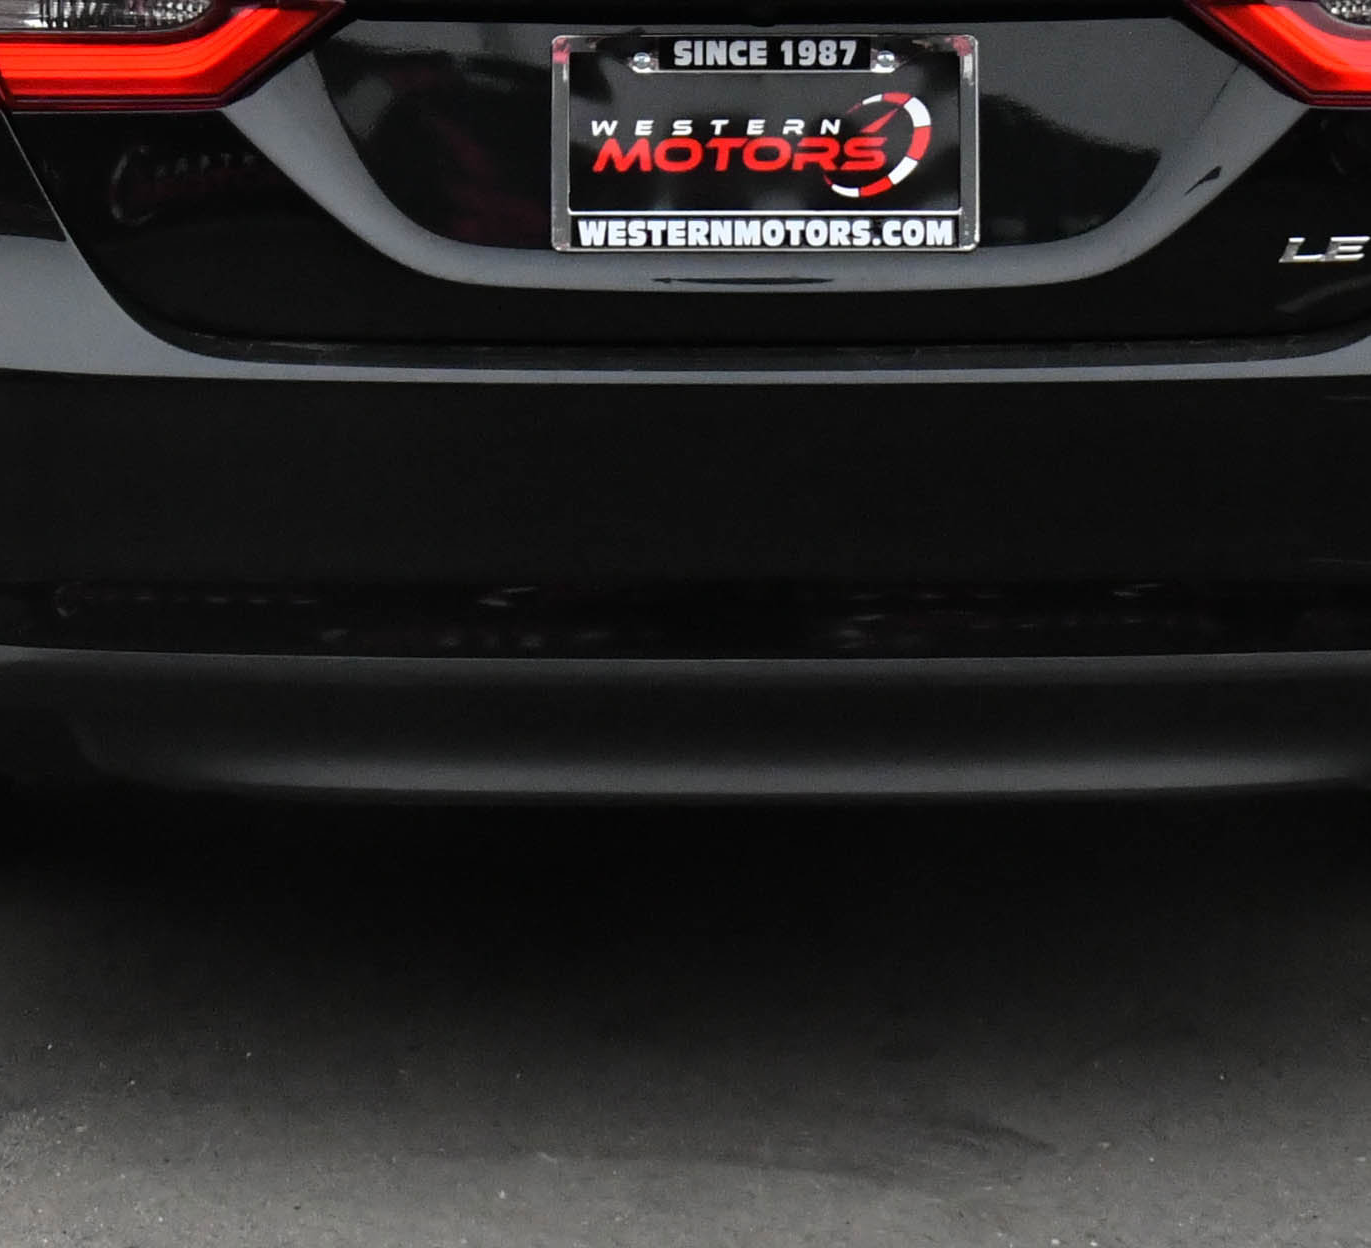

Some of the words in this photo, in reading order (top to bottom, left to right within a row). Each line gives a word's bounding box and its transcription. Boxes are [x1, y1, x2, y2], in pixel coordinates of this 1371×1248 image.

[673, 40, 768, 66] SINCE
[780, 40, 857, 66] 1987
[591, 119, 841, 136] WESTERN
[592, 137, 888, 173] MOTORS
[578, 219, 953, 246] WESTERNMOTORS.COM
[1278, 236, 1371, 263] LE
